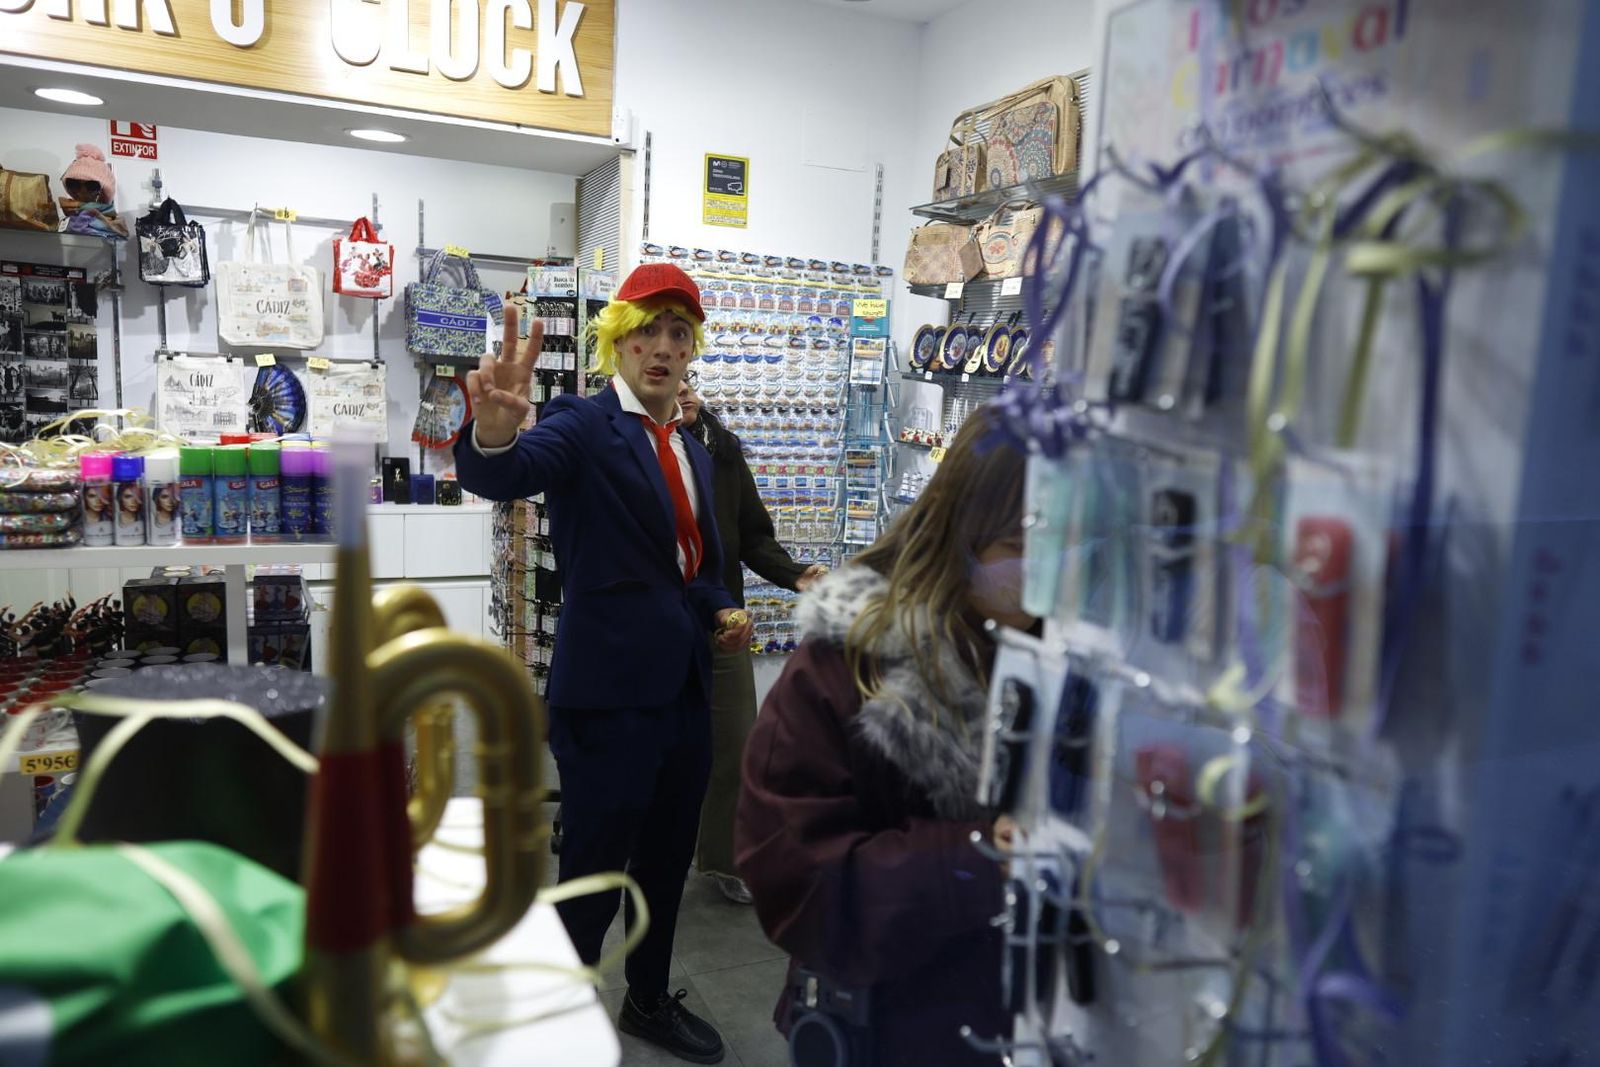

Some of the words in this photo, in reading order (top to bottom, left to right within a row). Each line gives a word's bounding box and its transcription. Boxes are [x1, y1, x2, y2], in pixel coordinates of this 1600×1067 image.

[112, 141, 156, 157] EXTINTOR
[439, 316, 480, 328] CÁDIZ
[189, 371, 214, 387] CÁDIZ
[26, 755, 76, 773] 5'95€
